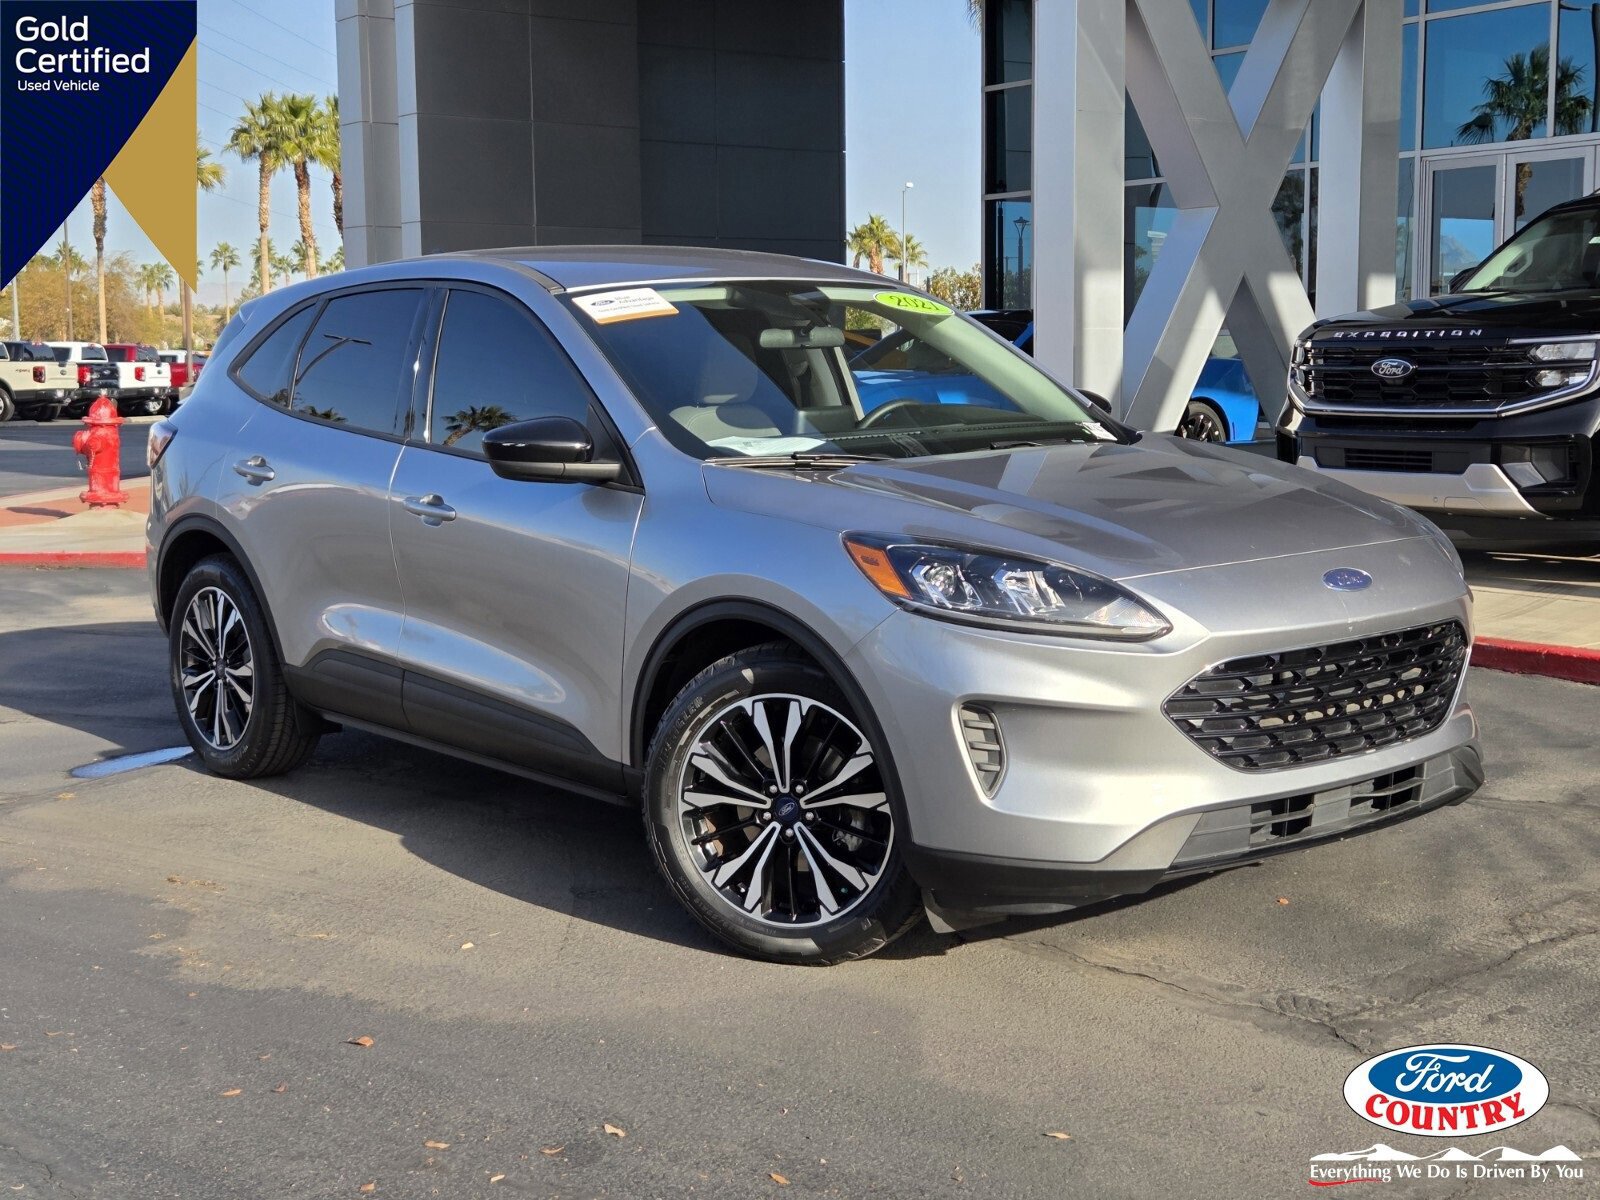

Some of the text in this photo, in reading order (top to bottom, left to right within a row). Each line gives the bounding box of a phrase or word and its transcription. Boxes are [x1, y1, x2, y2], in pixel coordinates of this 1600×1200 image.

[889, 295, 940, 310] 2021
[1333, 329, 1483, 339] EXPEDITION
[1378, 361, 1404, 376] Ford
